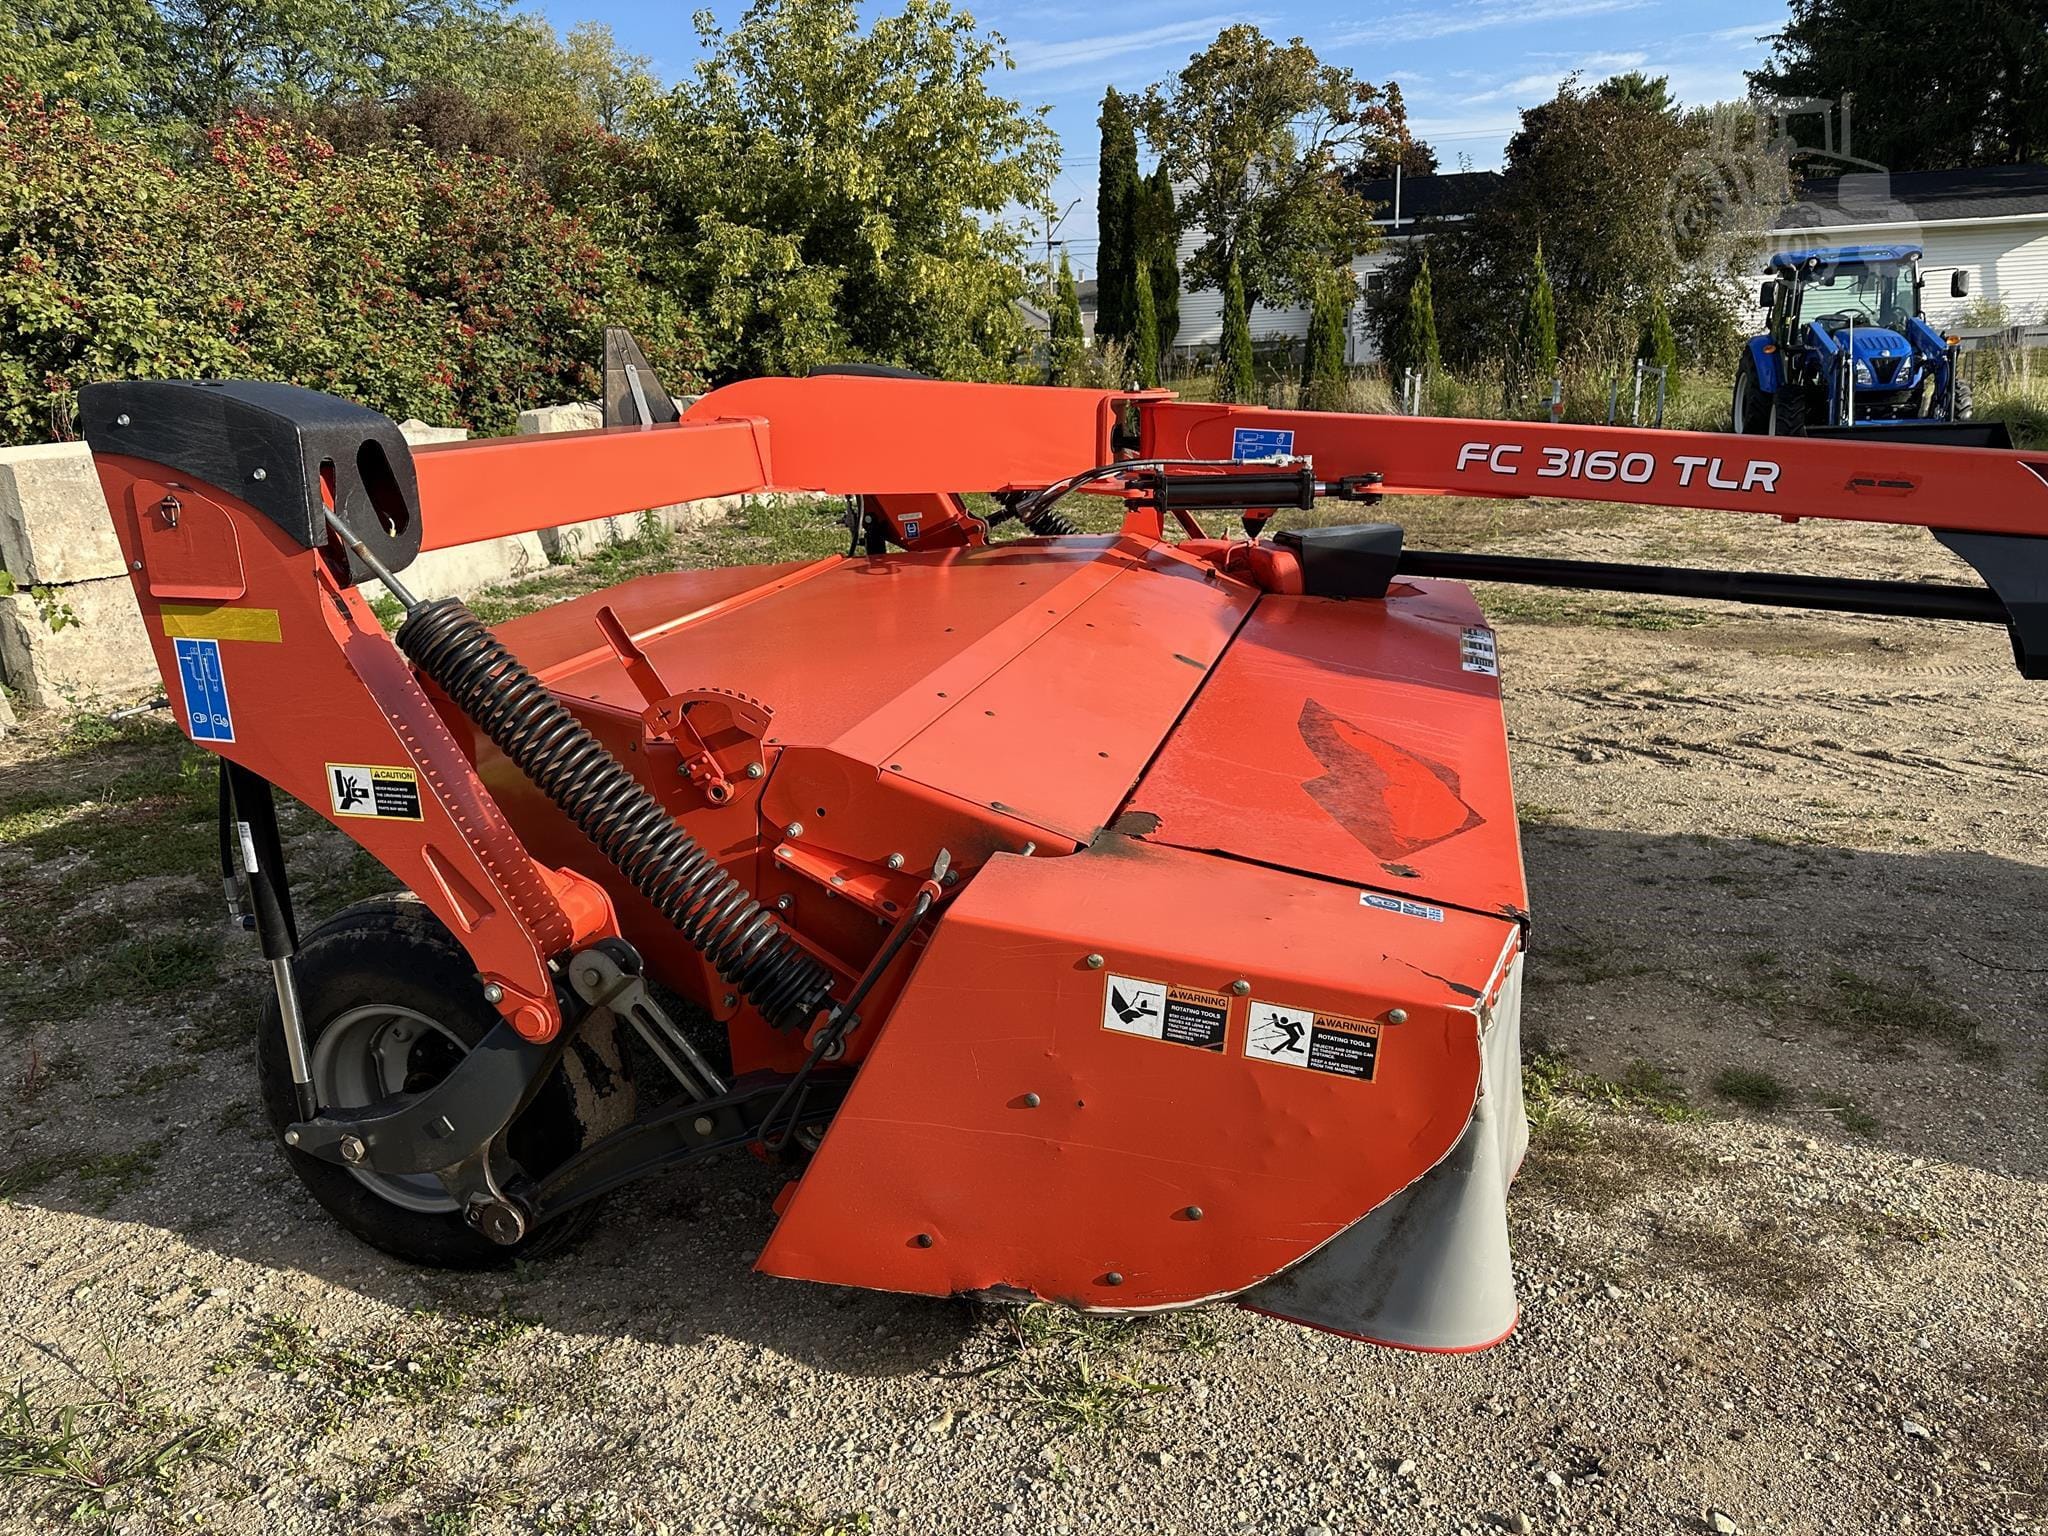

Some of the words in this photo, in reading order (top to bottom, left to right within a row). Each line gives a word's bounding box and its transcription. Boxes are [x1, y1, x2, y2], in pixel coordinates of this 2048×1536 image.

[1456, 442, 1523, 474] FC
[1536, 447, 1655, 484] 3160
[1673, 455, 1781, 494] TLR
[1179, 992, 1226, 1006] WARNING
[1171, 1005, 1200, 1015] ROTATING
[1326, 1019, 1376, 1034] WARNING
[1318, 1033, 1348, 1044] ROTATING
[1341, 1064, 1363, 1072] DISTANCE
